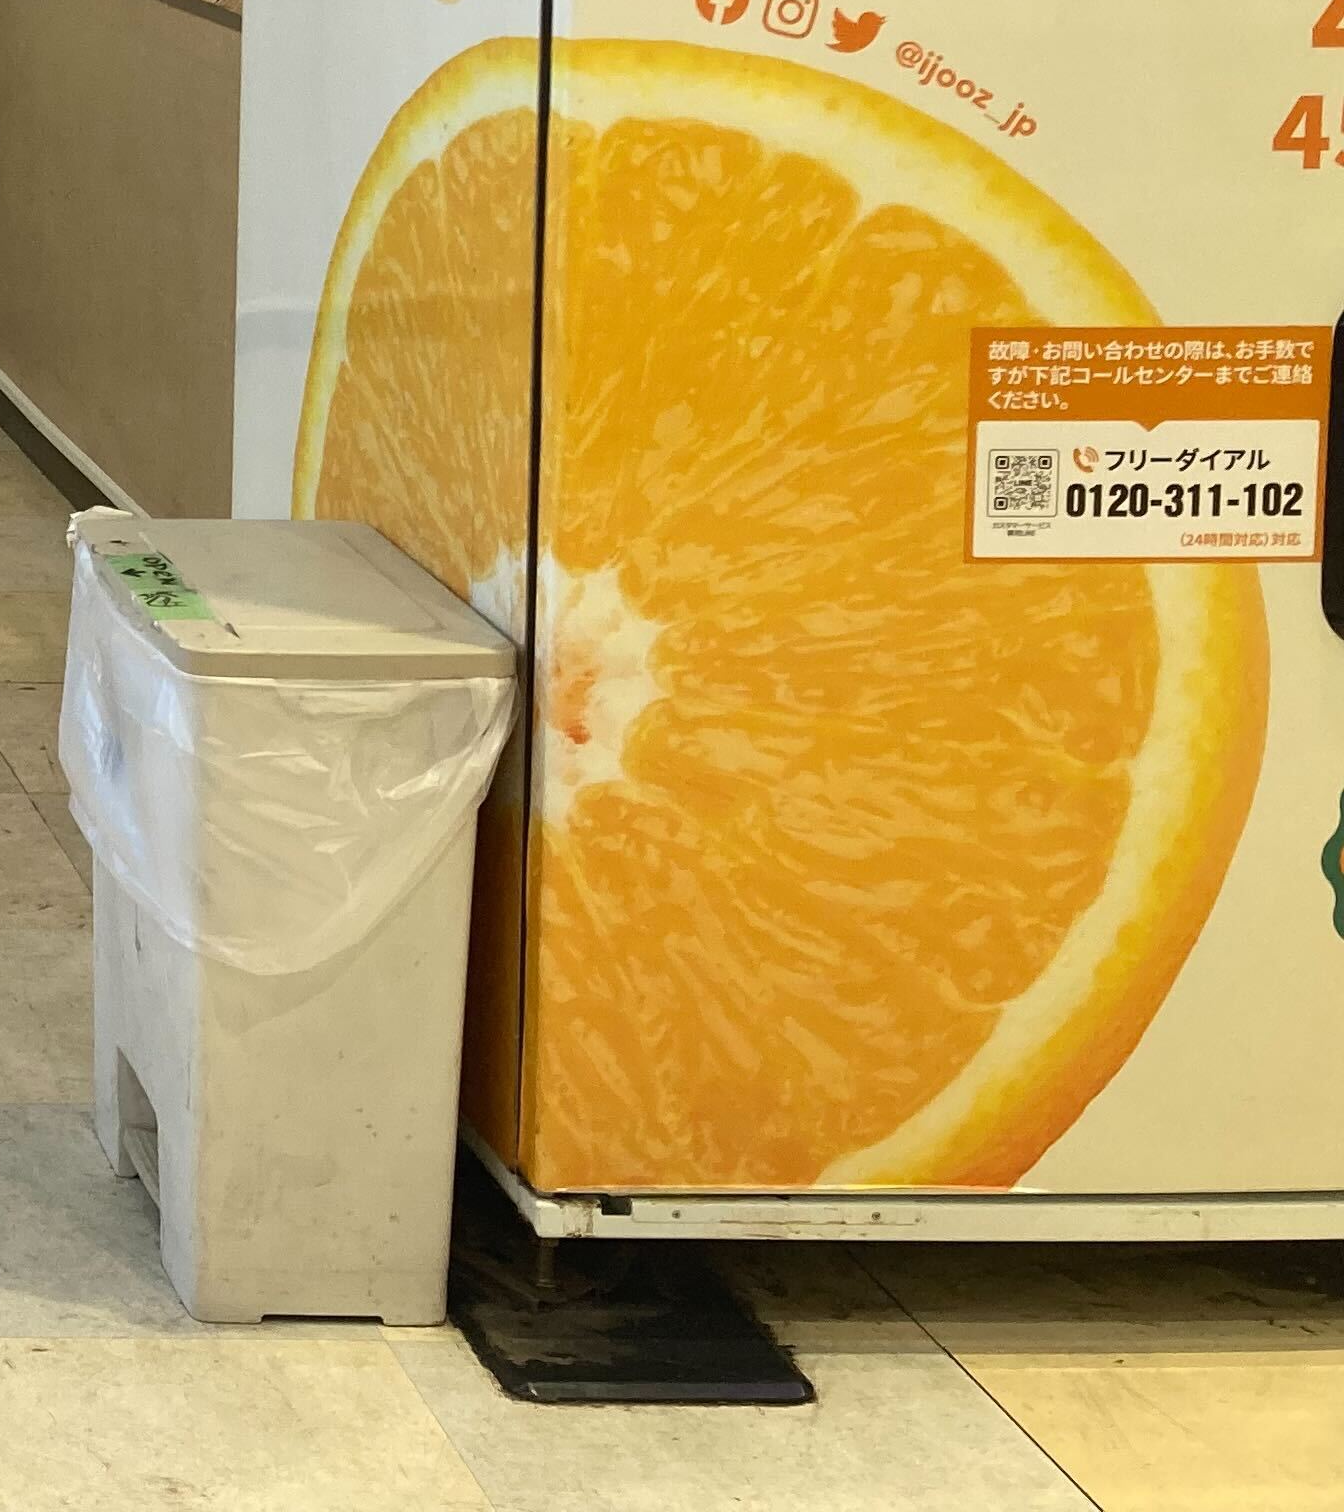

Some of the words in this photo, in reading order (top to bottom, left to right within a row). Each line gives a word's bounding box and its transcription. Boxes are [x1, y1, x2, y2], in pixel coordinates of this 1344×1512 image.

[895, 40, 1038, 138] @ijooz_jp
[988, 339, 1314, 362] 故障・お問い合わせの際は、お手数で
[988, 364, 1313, 386] すが下記コールセンターまでご連絡
[988, 390, 1069, 410] ください。
[1105, 449, 1270, 472] フリーダイアル
[1066, 483, 1303, 519] 0120-311-102
